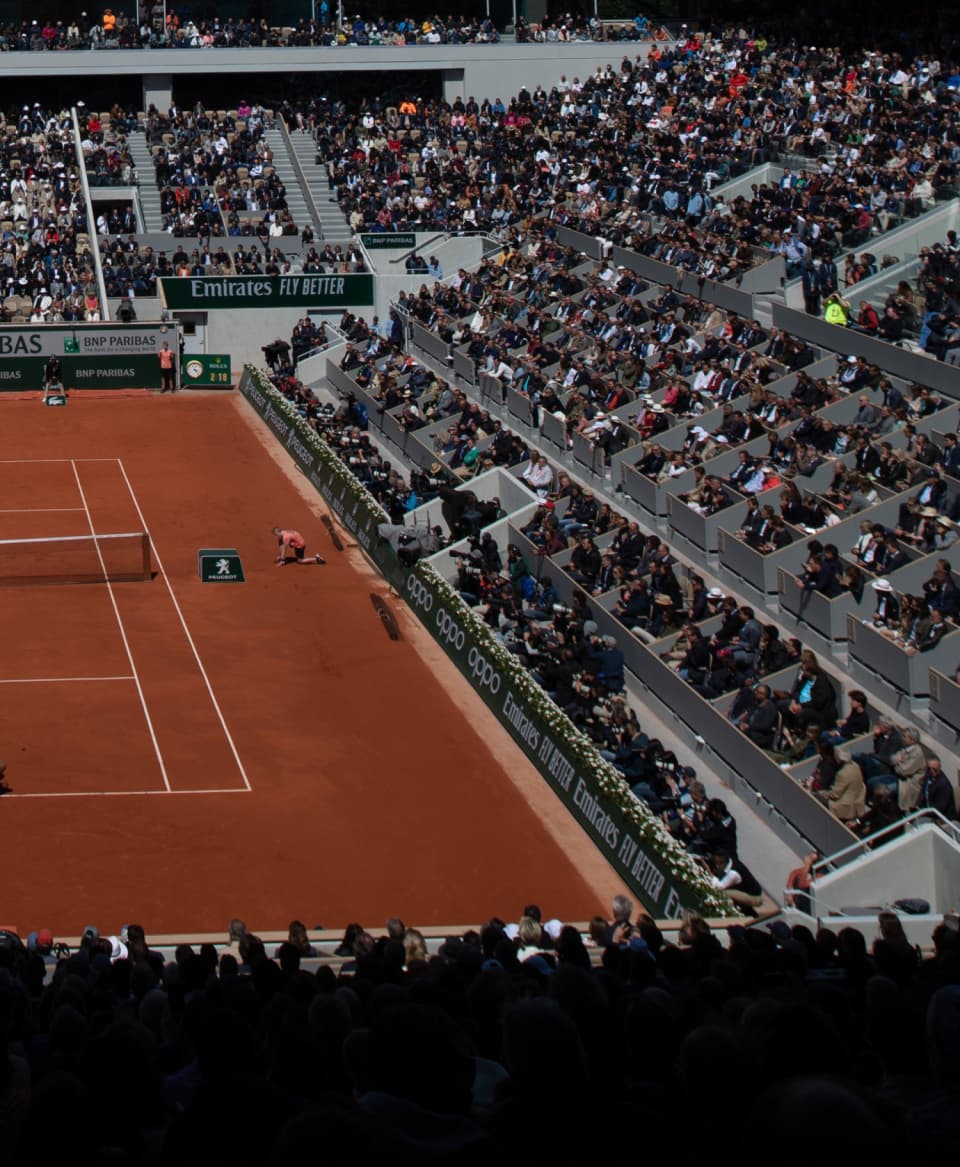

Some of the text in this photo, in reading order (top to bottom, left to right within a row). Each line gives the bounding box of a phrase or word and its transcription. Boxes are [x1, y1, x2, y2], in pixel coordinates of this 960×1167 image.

[191, 277, 345, 297] Emirates FLY BETTER
[84, 335, 156, 347] BNP PARIBAS
[97, 368, 135, 377] PARIBAS
[407, 574, 433, 612] oppo
[436, 608, 465, 650] oppo
[468, 647, 501, 694] oppo
[503, 691, 575, 792] Emirates FLY BETTER
[574, 776, 665, 903] Emirates FLY BETTER
